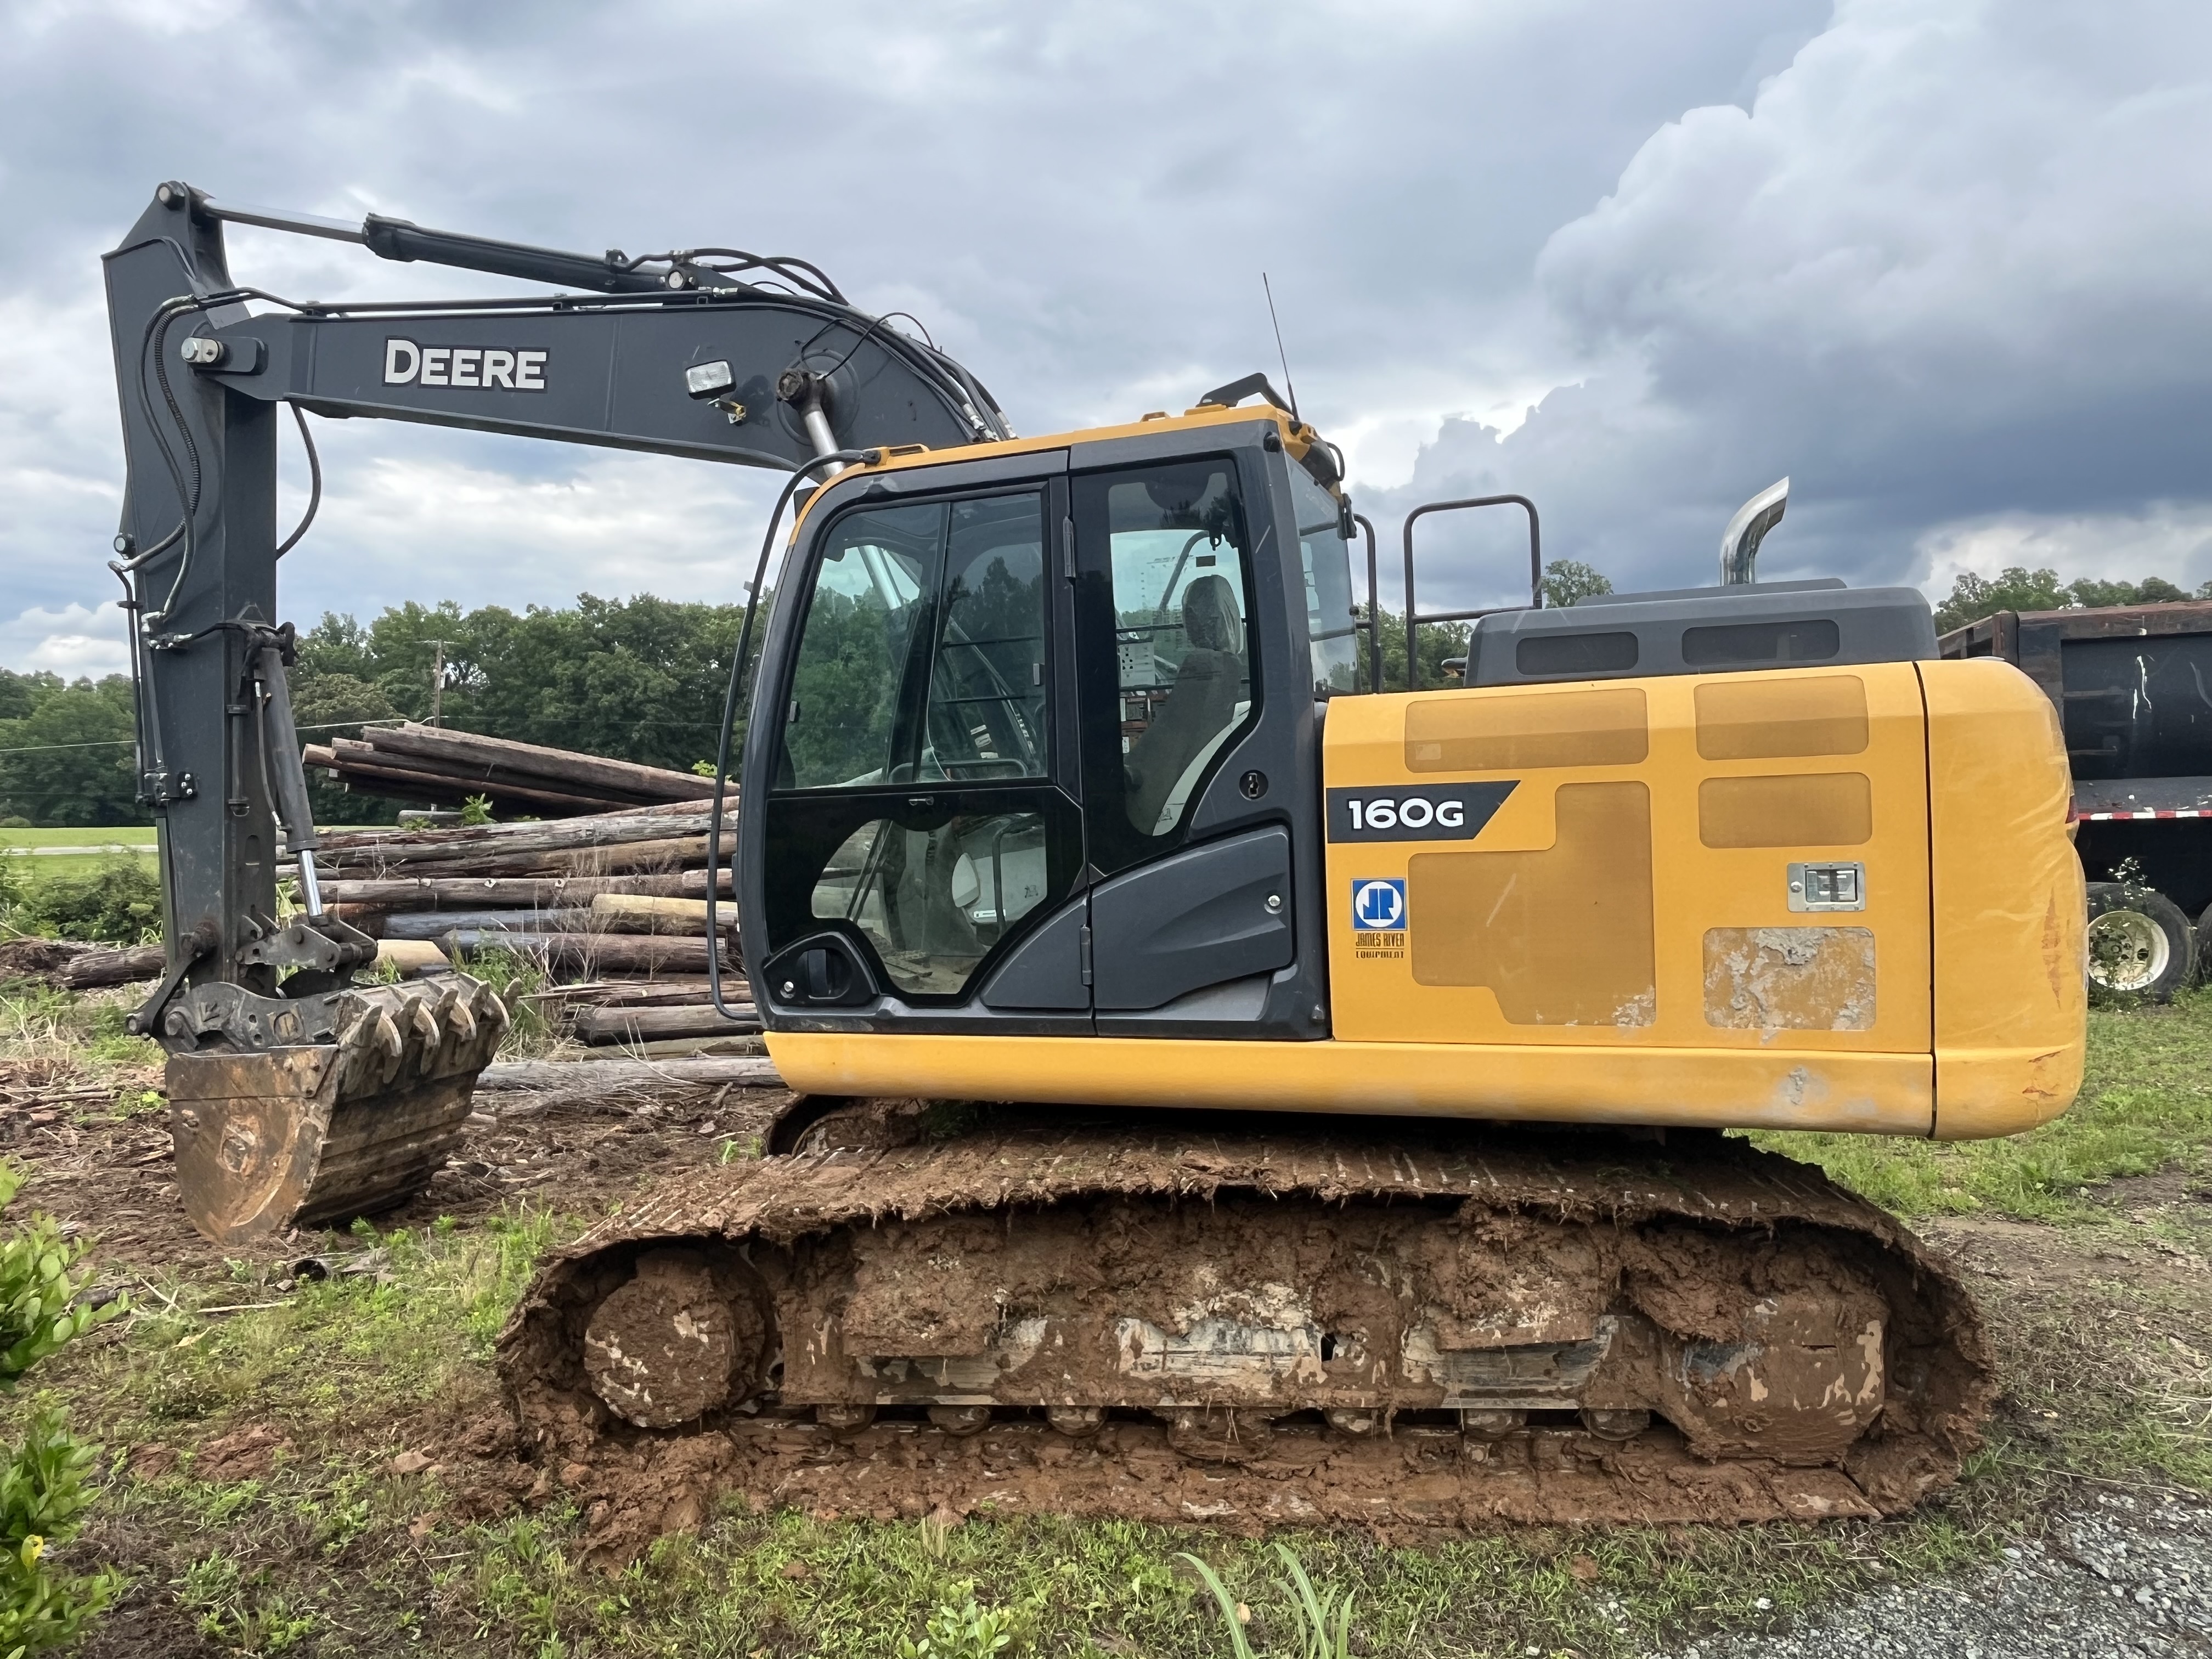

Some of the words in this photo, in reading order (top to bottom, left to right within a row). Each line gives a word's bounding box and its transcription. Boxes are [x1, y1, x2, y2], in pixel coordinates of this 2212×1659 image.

[385, 339, 547, 389] DEERE
[1348, 798, 1464, 830] 160G
[1356, 933, 1381, 947] JAMES
[1383, 933, 1404, 947] RIVER
